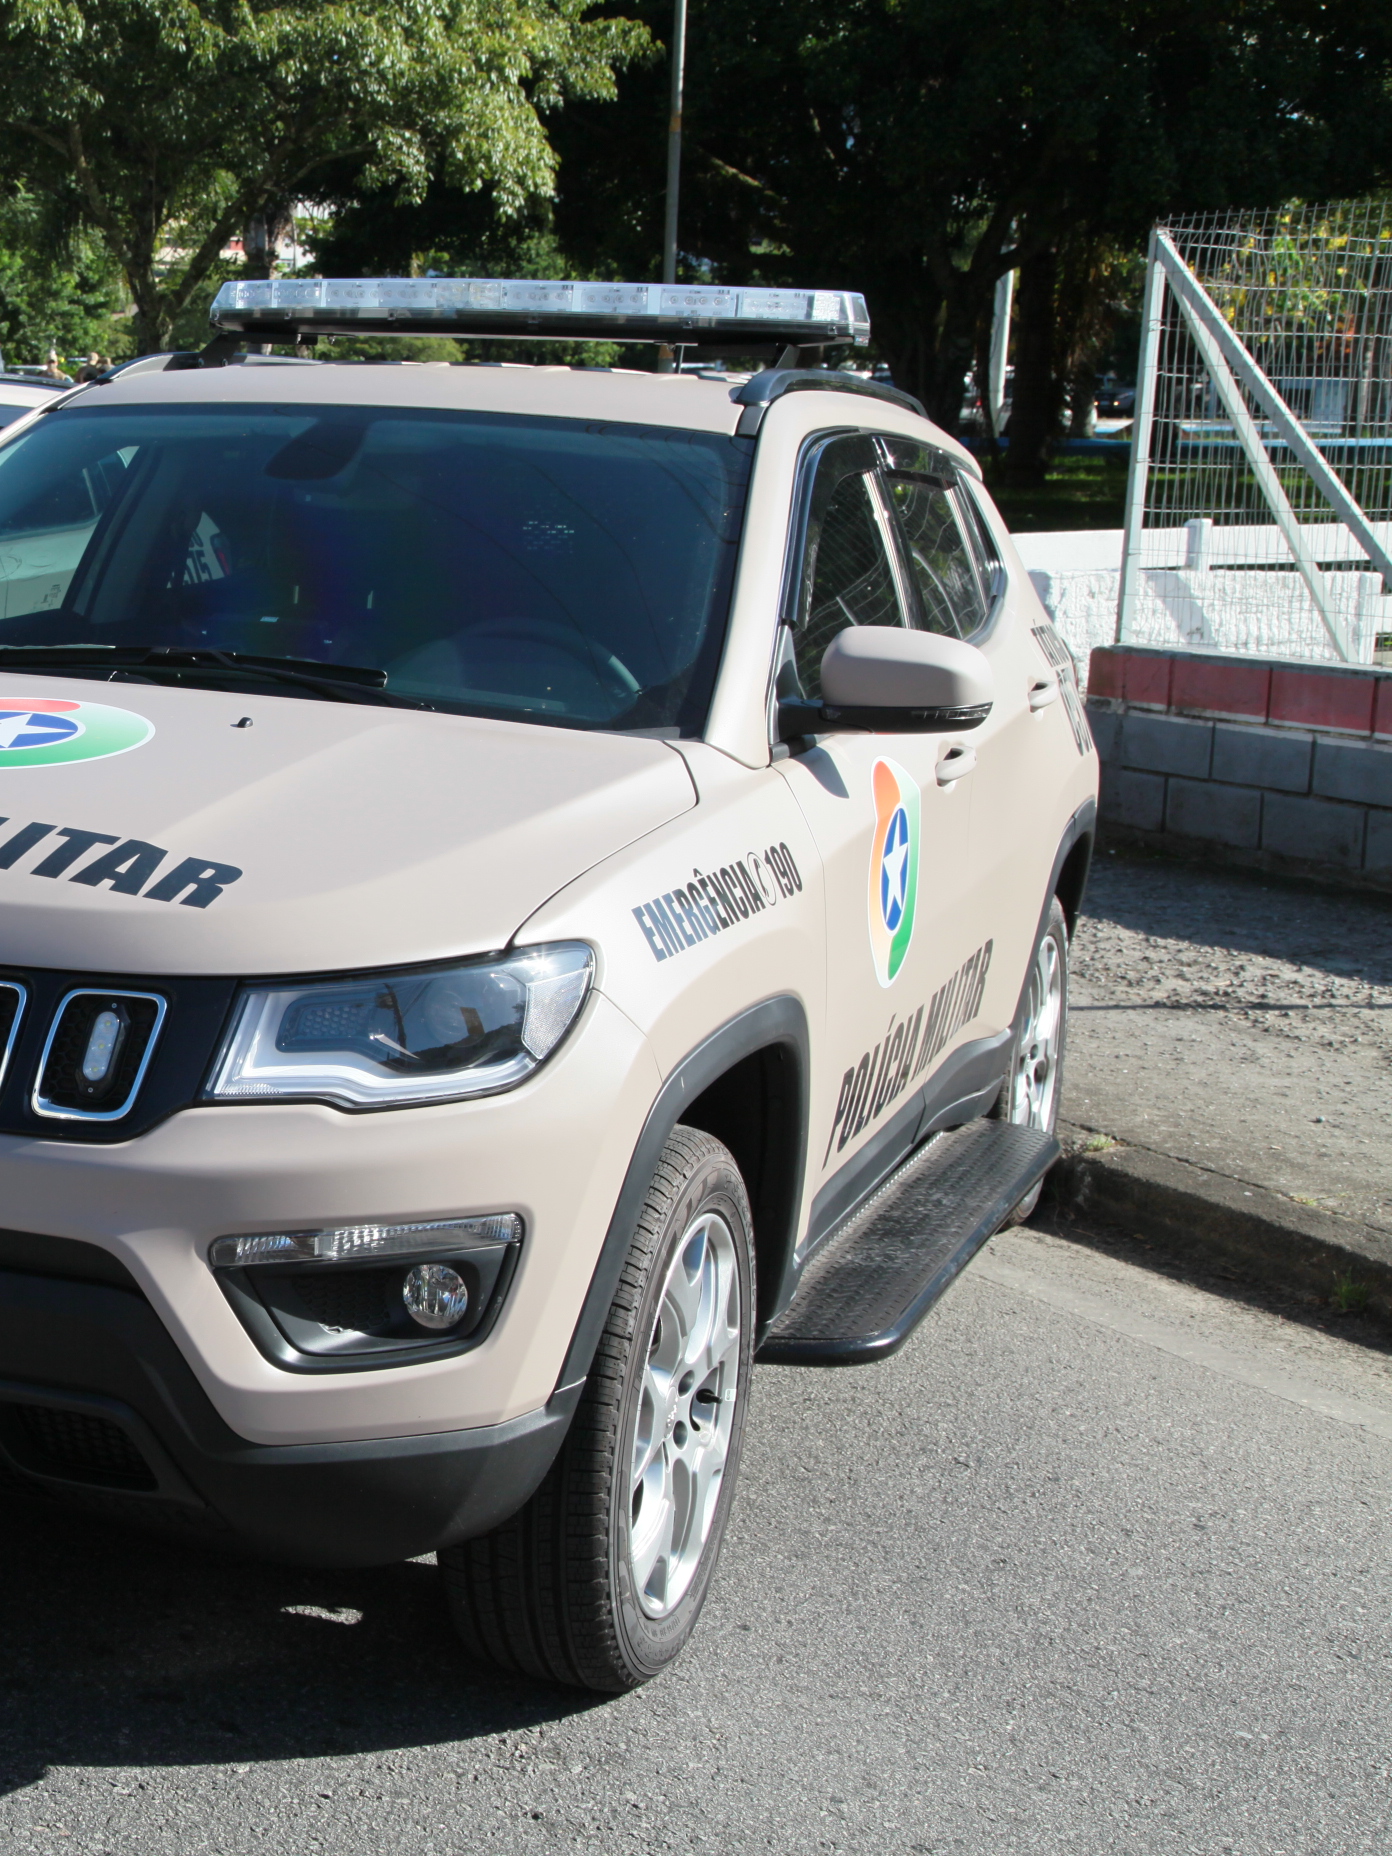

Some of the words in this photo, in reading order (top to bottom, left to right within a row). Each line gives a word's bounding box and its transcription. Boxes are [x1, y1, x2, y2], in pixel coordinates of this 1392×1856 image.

[631, 868, 766, 963] EMERGÊNCIA
[764, 841, 803, 899] 190
[821, 1003, 925, 1172] POLÍCIA
[910, 938, 993, 1084] MILITAR
